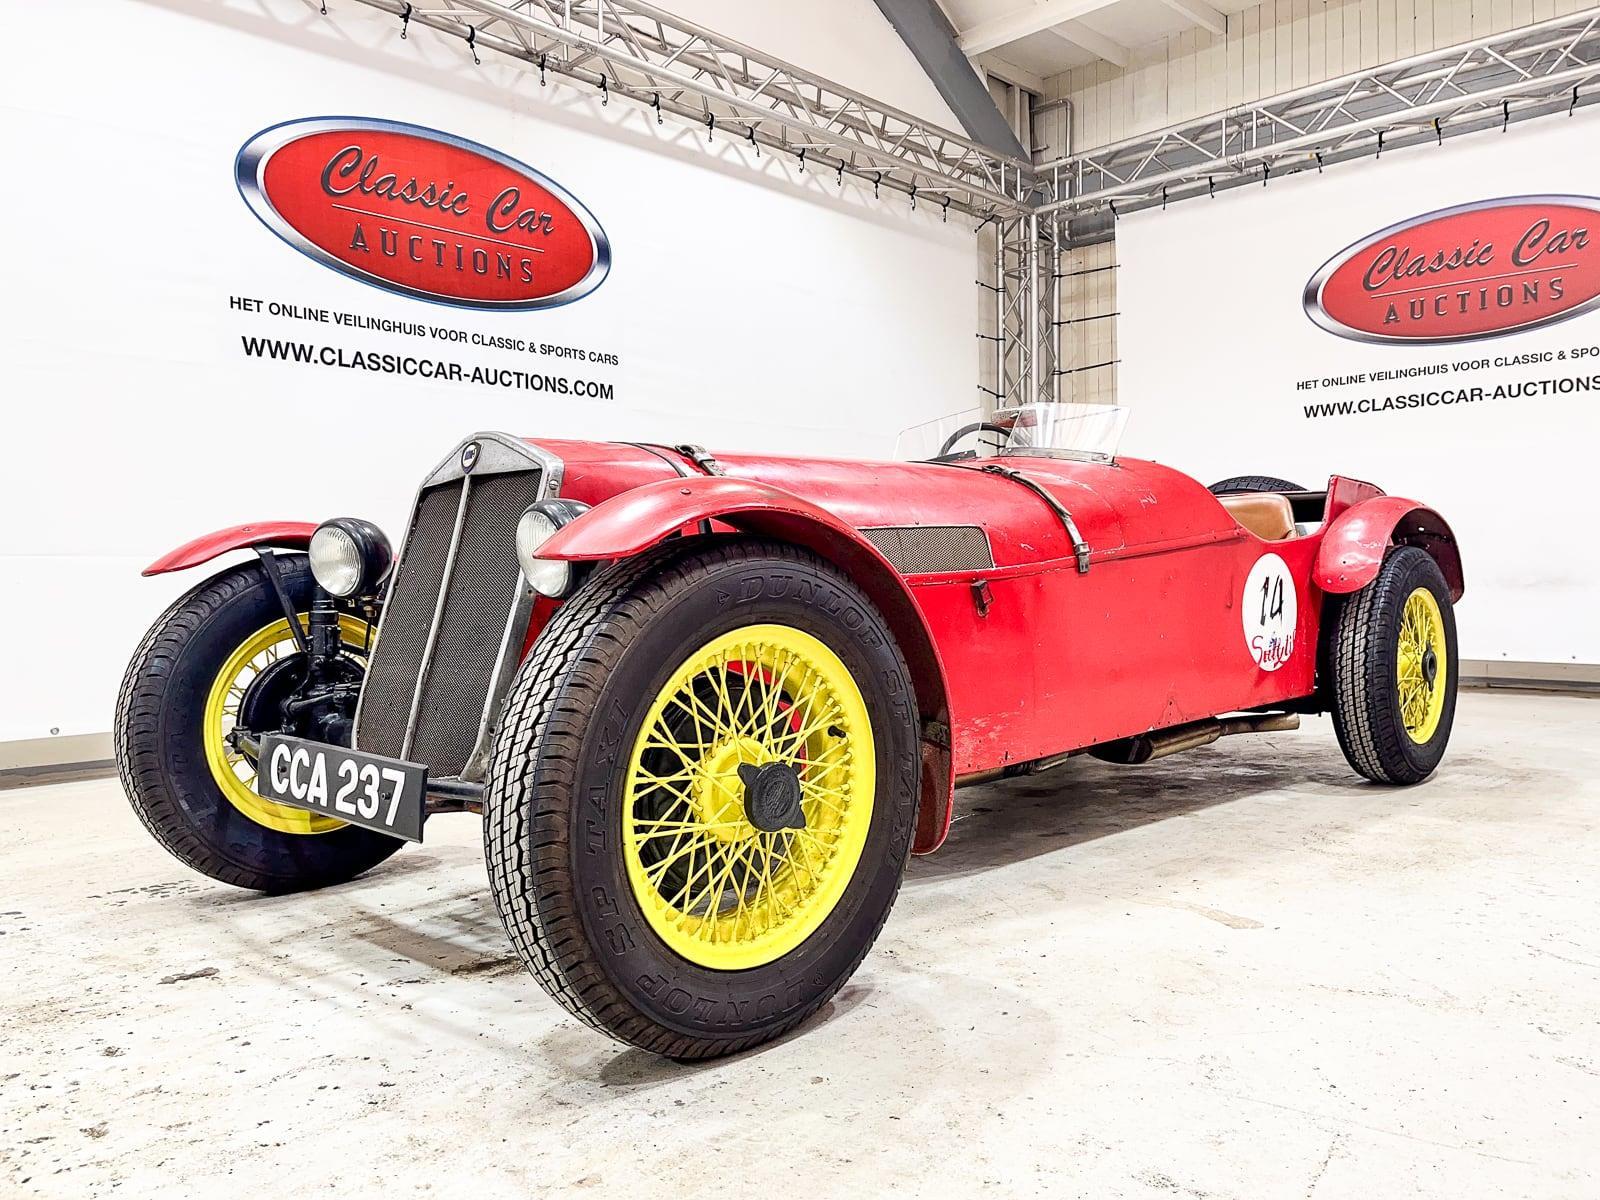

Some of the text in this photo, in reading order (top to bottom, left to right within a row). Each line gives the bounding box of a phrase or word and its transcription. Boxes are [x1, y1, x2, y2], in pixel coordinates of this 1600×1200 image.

[321, 145, 556, 236] Classic Car
[349, 222, 535, 283] AUCTIONS
[1362, 217, 1591, 291] Classic Car
[230, 296, 618, 365] HET ONLINE VEILINGHUIS VOOR CLASSIC & SPORTS CARS
[1383, 277, 1565, 324] AUCTIONS
[241, 335, 615, 400] WWW.CLASSICCAR-AUCTIONS.COM
[1297, 380, 1318, 390] HET
[1322, 374, 1365, 387] ONLINE
[1369, 364, 1448, 381] VEILINGHUIS
[1452, 360, 1489, 371] VOOR
[1495, 352, 1552, 367] CLASSIC
[1558, 351, 1566, 360] &
[736, 575, 883, 650] DUNLOP
[1260, 575, 1283, 626] 14
[271, 744, 405, 826] CCA 237
[584, 698, 630, 857] TAXI
[591, 886, 636, 955] SP
